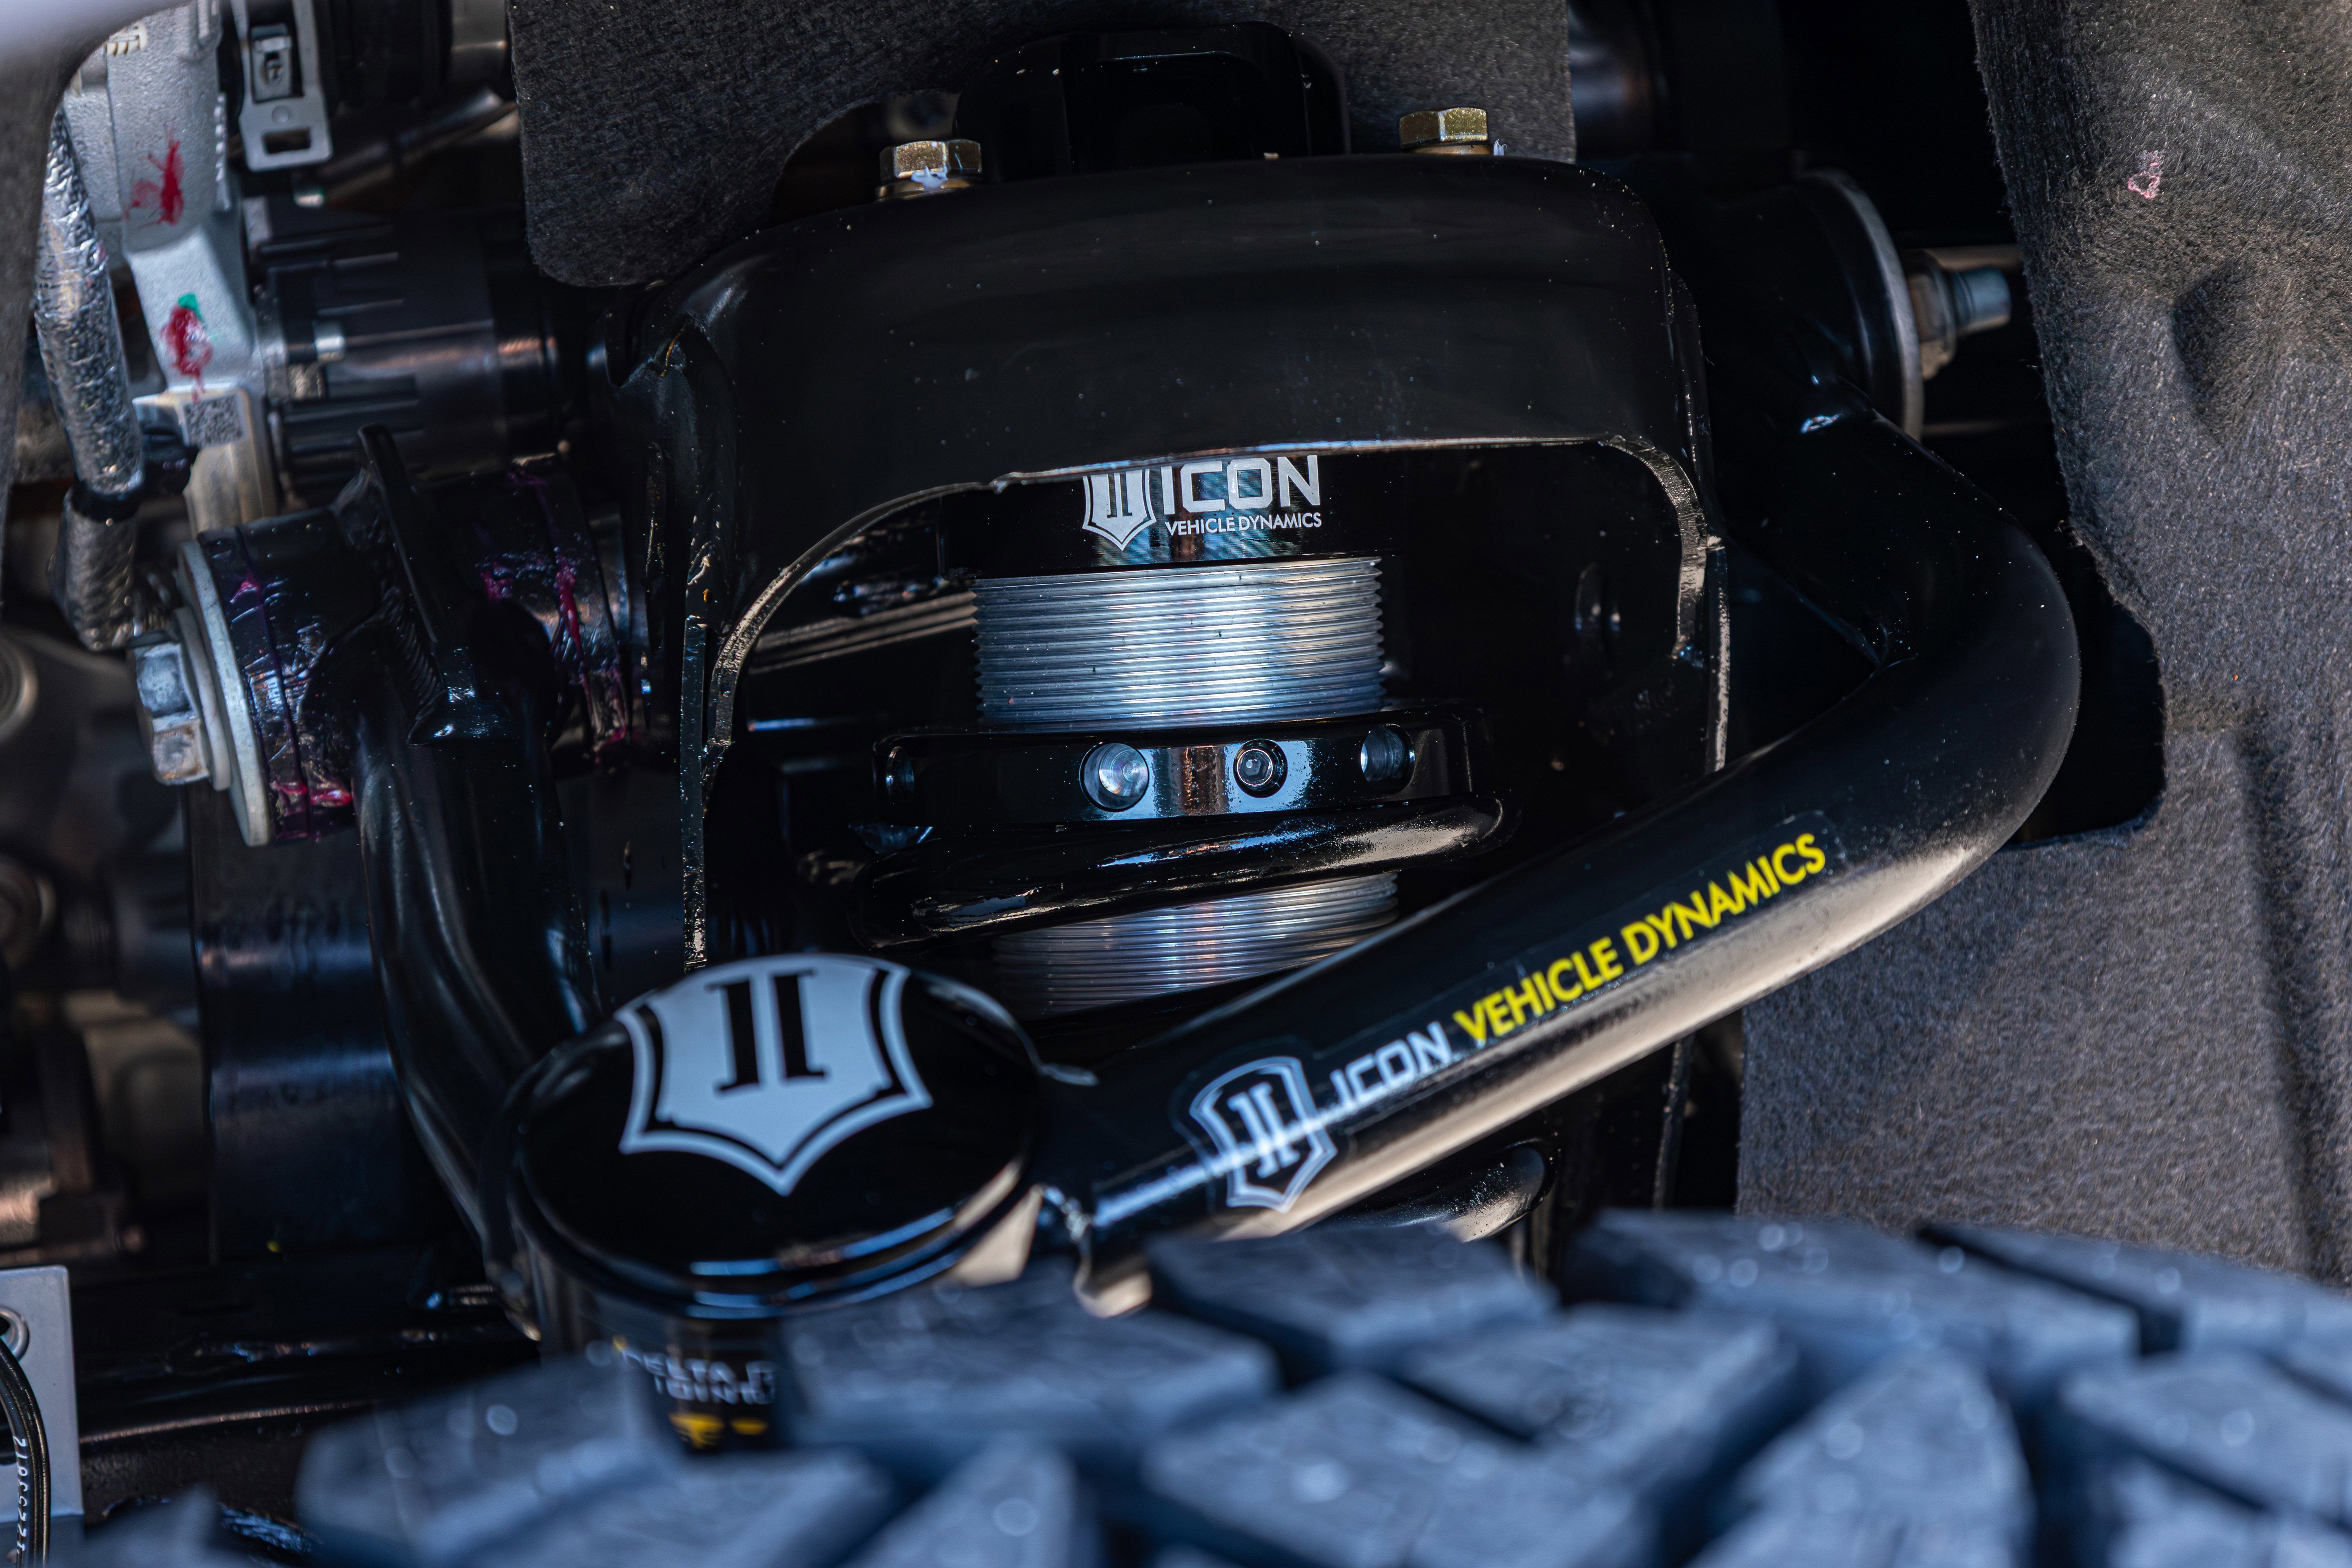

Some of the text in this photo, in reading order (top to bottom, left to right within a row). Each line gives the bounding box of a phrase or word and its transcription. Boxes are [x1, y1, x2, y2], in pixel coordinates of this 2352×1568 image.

[1161, 455, 1321, 515] ICON
[1165, 512, 1322, 536] VEHICLE DYNAMICS
[1329, 833, 1826, 1111] ICON VEHICLE DYNAMICS
